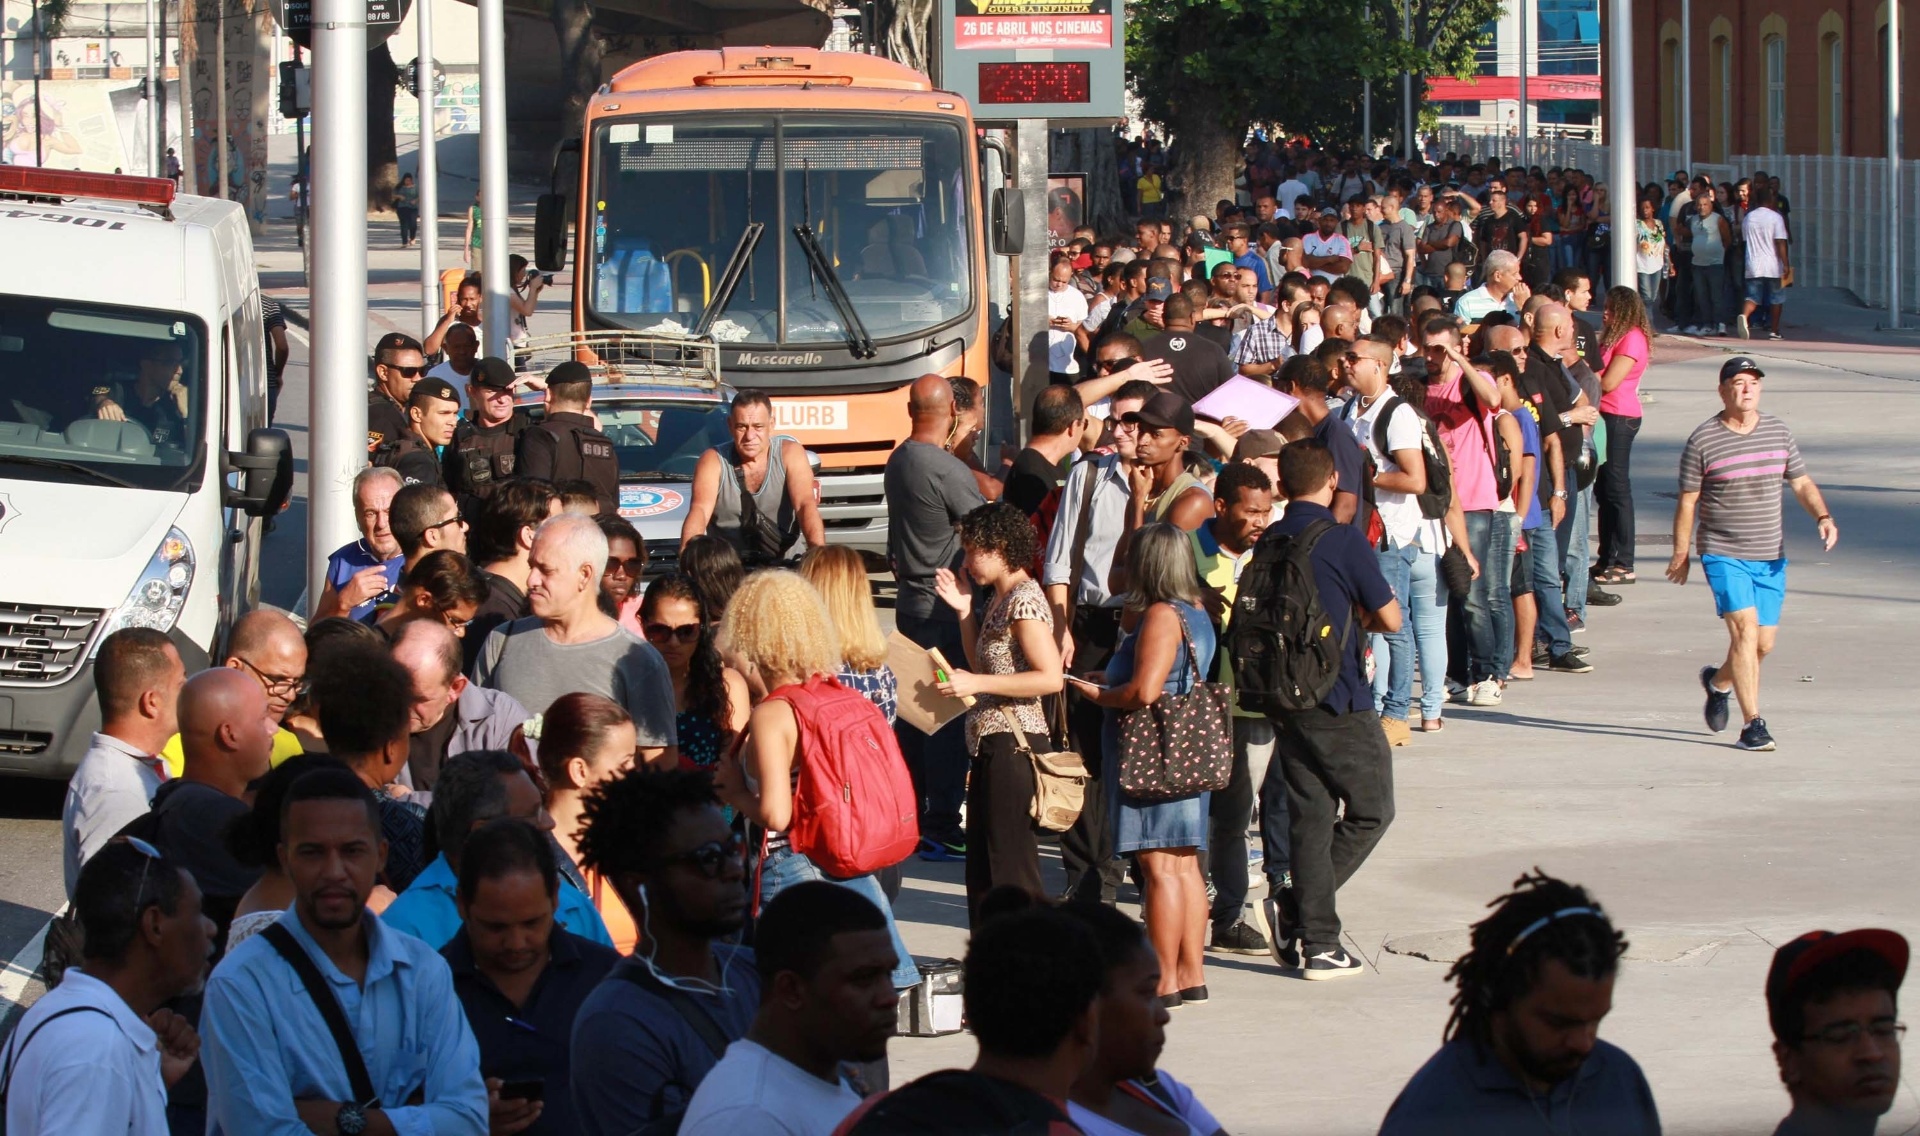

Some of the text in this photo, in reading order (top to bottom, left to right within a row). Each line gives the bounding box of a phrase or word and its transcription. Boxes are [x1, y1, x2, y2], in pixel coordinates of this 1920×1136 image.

[988, 4, 1090, 13] GUERRA INFINITA
[963, 20, 1104, 36] 26 DE ABRIL NOS CINEMAS
[737, 352, 823, 366] Mascarello
[773, 405, 835, 427] LURB
[583, 442, 610, 458] GOE
